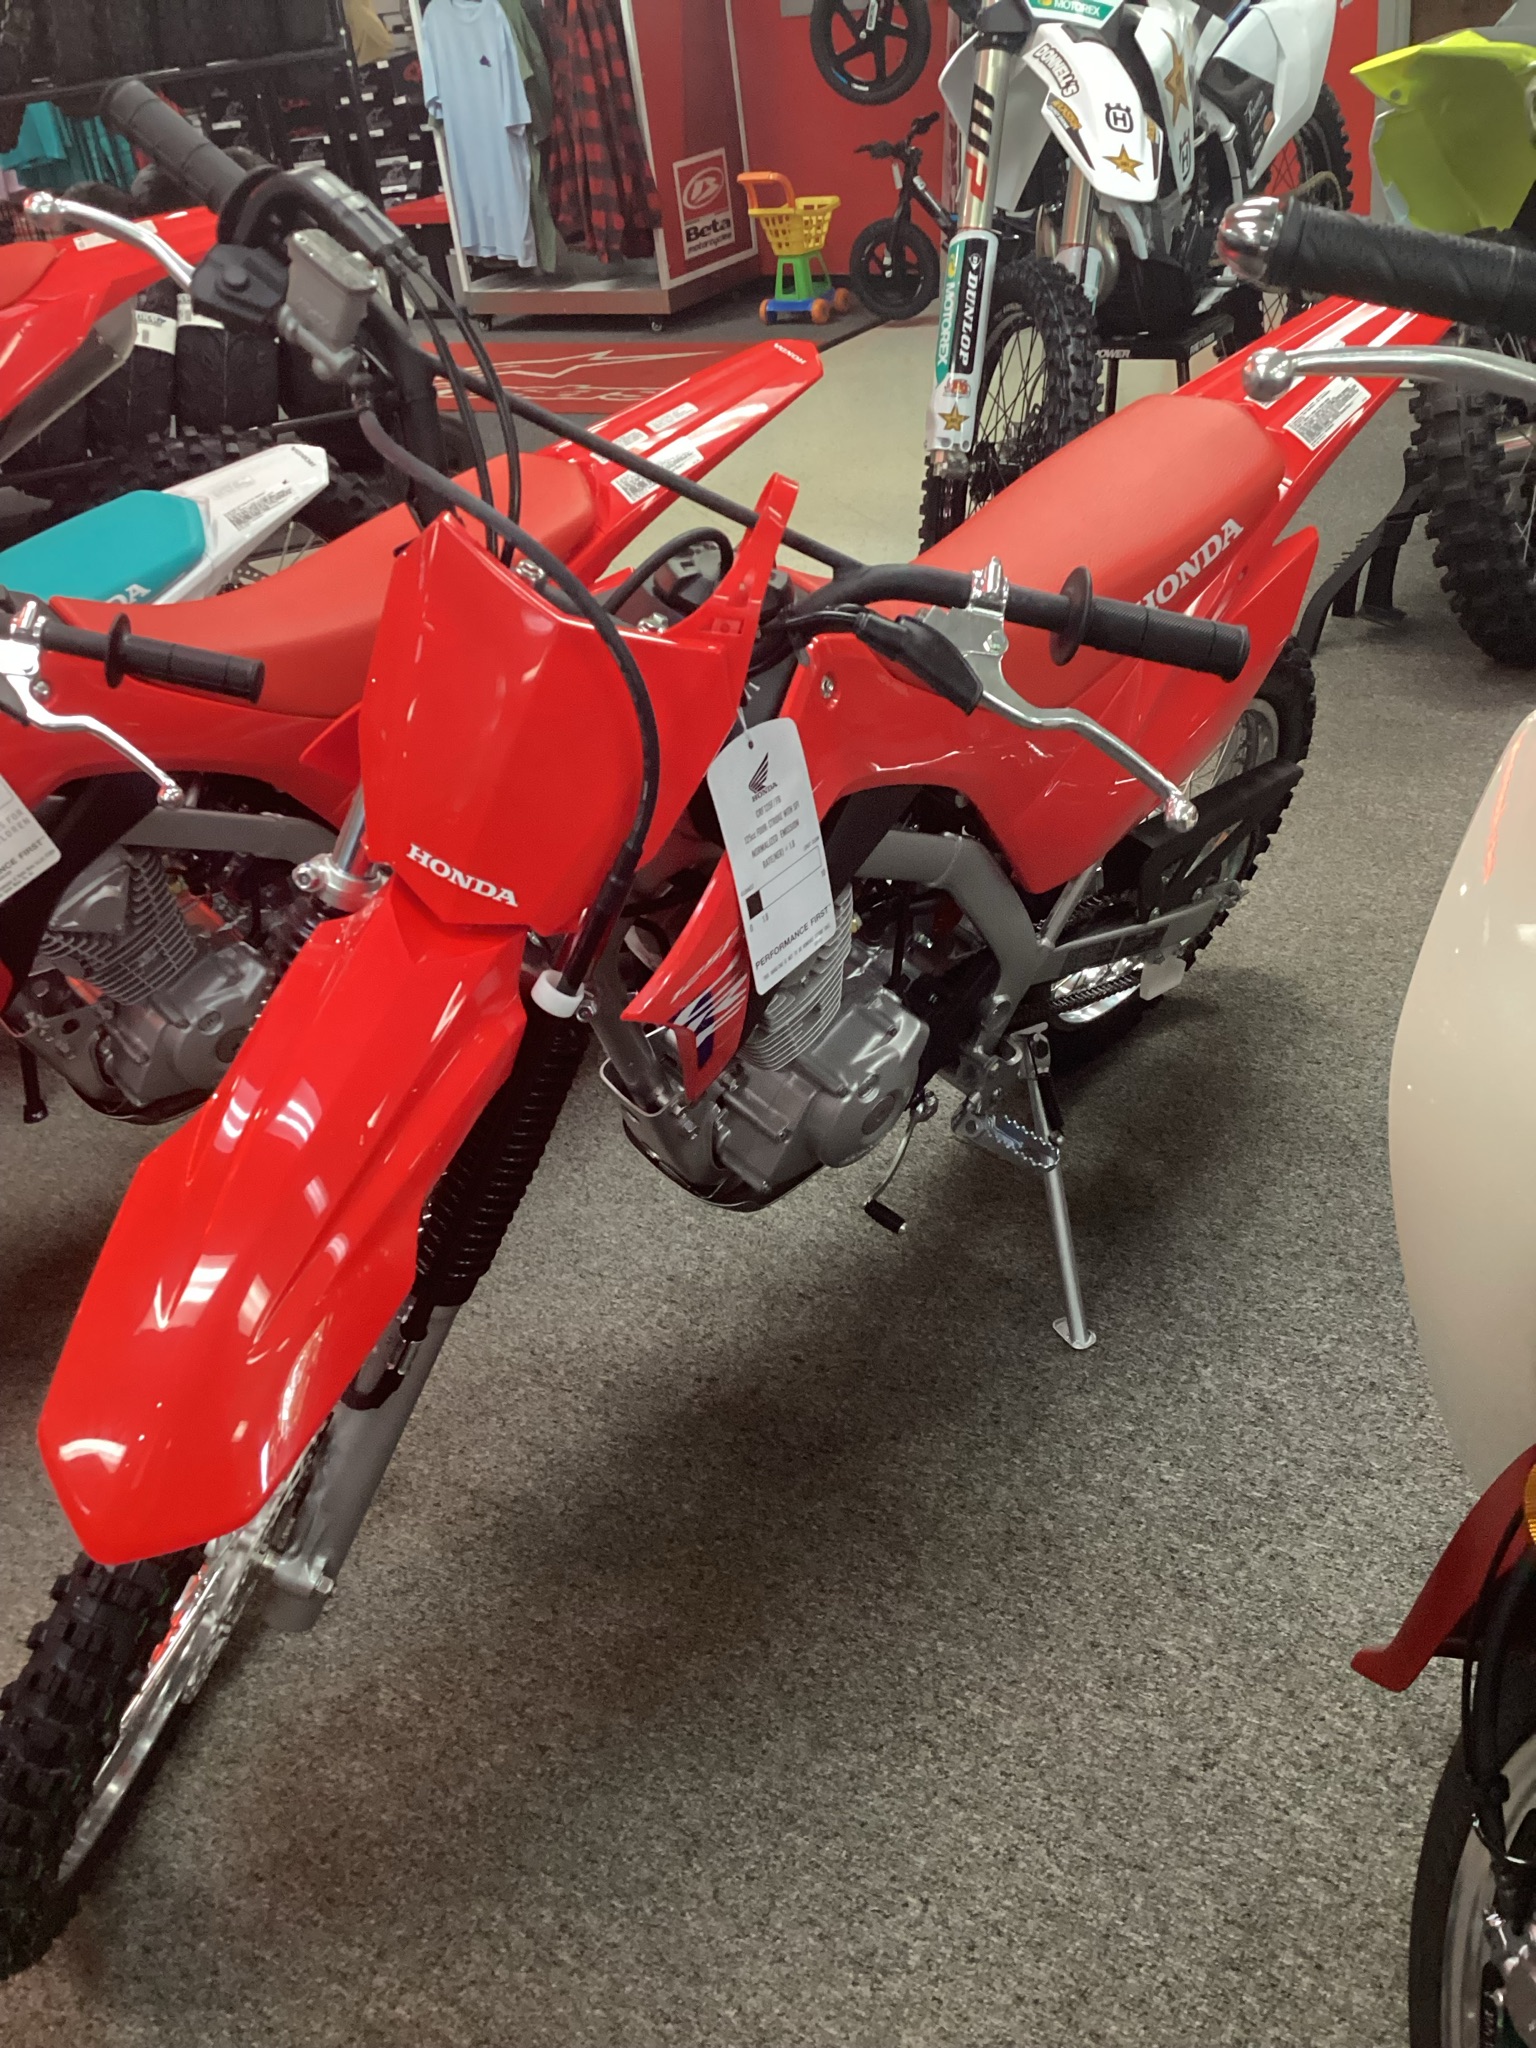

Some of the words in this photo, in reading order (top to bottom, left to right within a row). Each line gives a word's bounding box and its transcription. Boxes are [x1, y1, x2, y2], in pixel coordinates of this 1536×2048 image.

[1053, 0, 1101, 17] MOTOREX
[1032, 42, 1080, 98] DONNELL'S
[685, 218, 731, 242] Beta
[938, 281, 956, 366] MOTOREX
[959, 270, 979, 366] DUNLOP
[752, 782, 778, 802] HONDA
[406, 843, 519, 907] HONDA
[755, 924, 809, 971] PERFORMANCE
